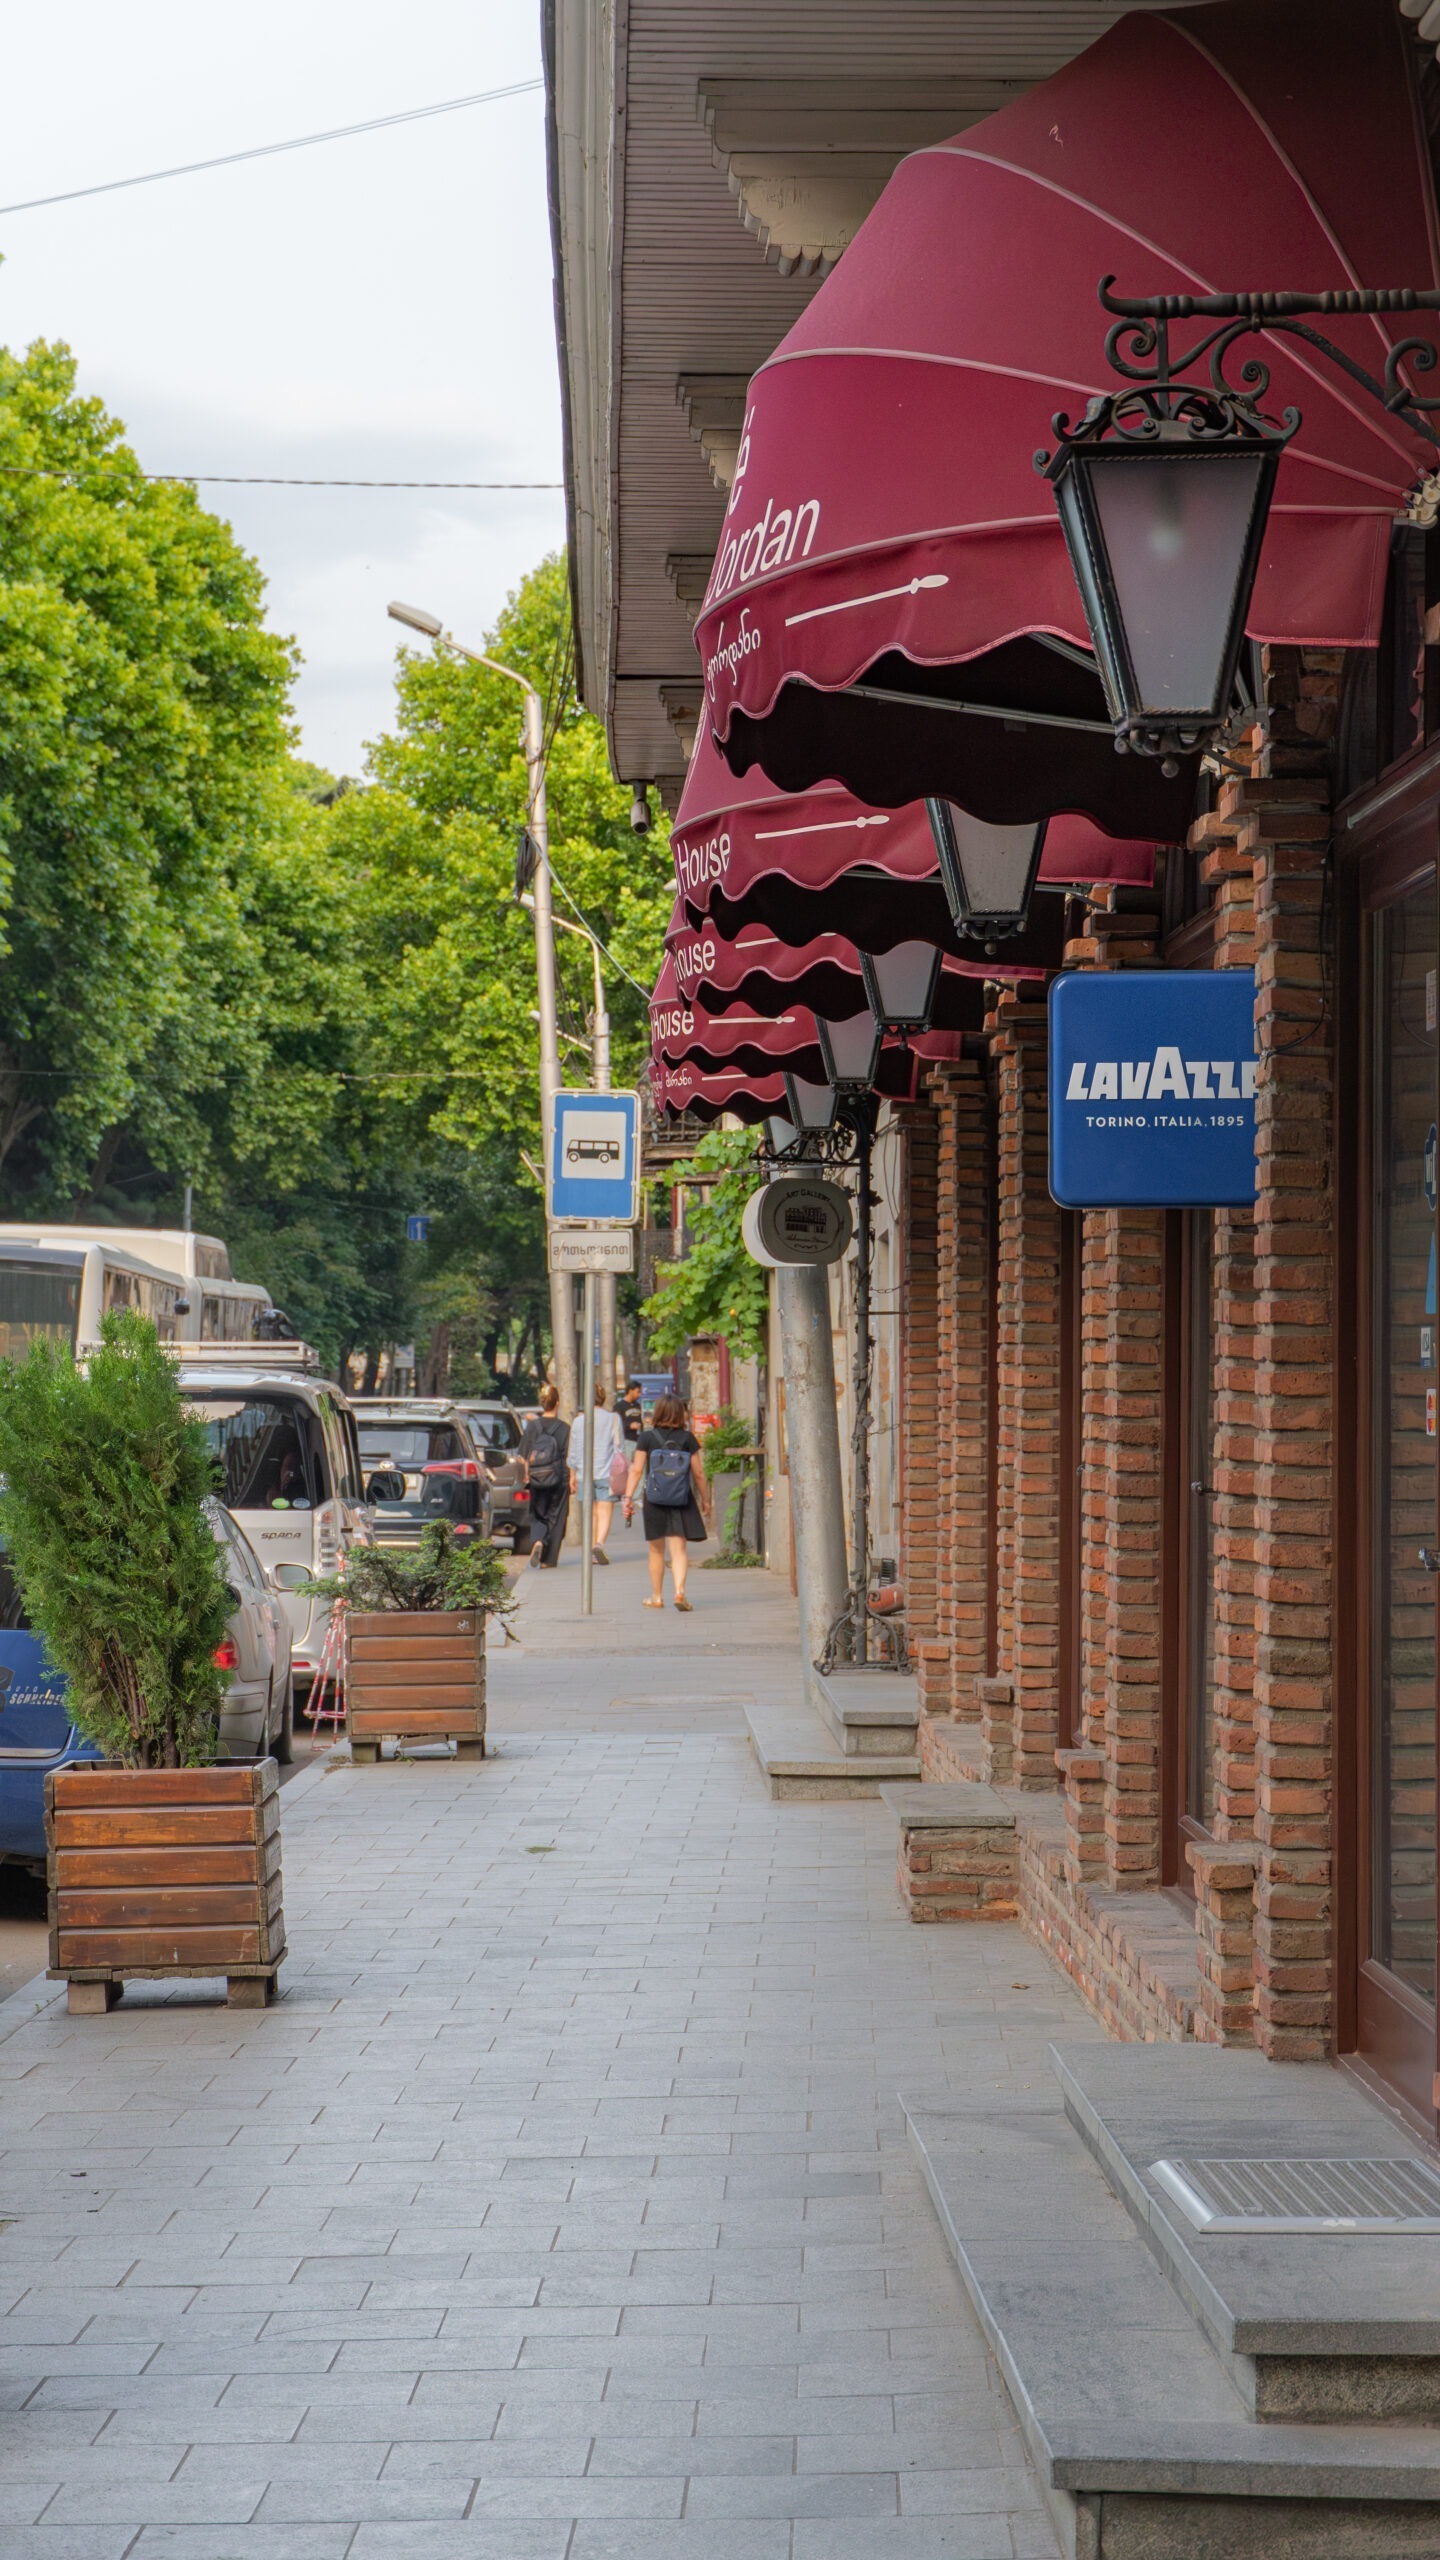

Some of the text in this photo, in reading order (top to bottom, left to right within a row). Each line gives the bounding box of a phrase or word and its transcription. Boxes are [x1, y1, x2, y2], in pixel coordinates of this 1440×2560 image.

[704, 498, 820, 608] Jordan
[676, 832, 731, 896] House
[651, 1007, 695, 1043] House
[1065, 1046, 1260, 1101] LAVAZZA
[1210, 1115, 1245, 1127] 1895
